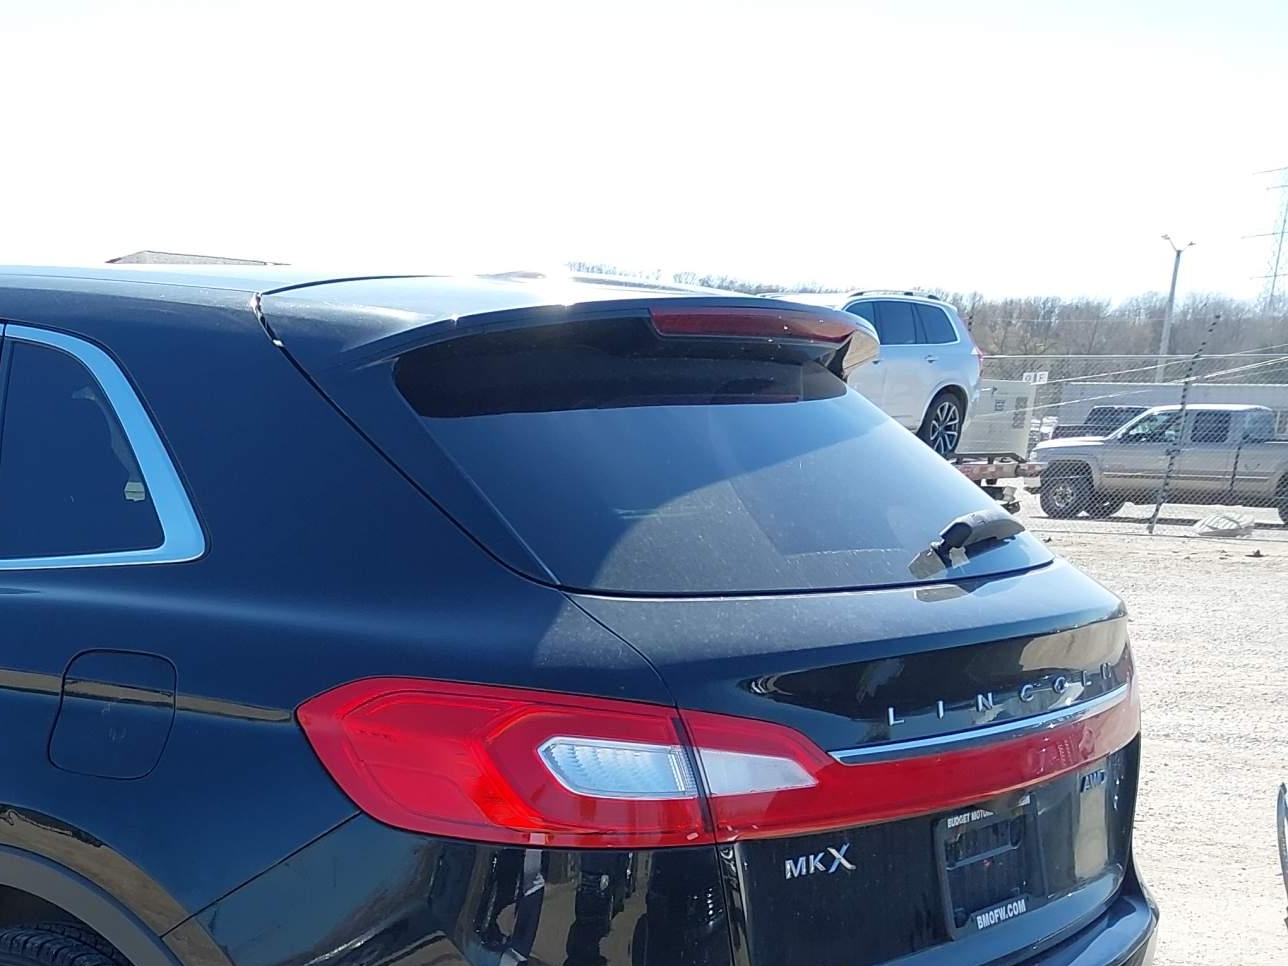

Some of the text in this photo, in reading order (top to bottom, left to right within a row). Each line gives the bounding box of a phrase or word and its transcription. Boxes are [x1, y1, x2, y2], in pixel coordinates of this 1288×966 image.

[887, 661, 1112, 726] LINCOLN
[947, 812, 970, 829] BUDGET
[785, 843, 856, 879] MKX
[976, 899, 1026, 930] BMOFW.COM
